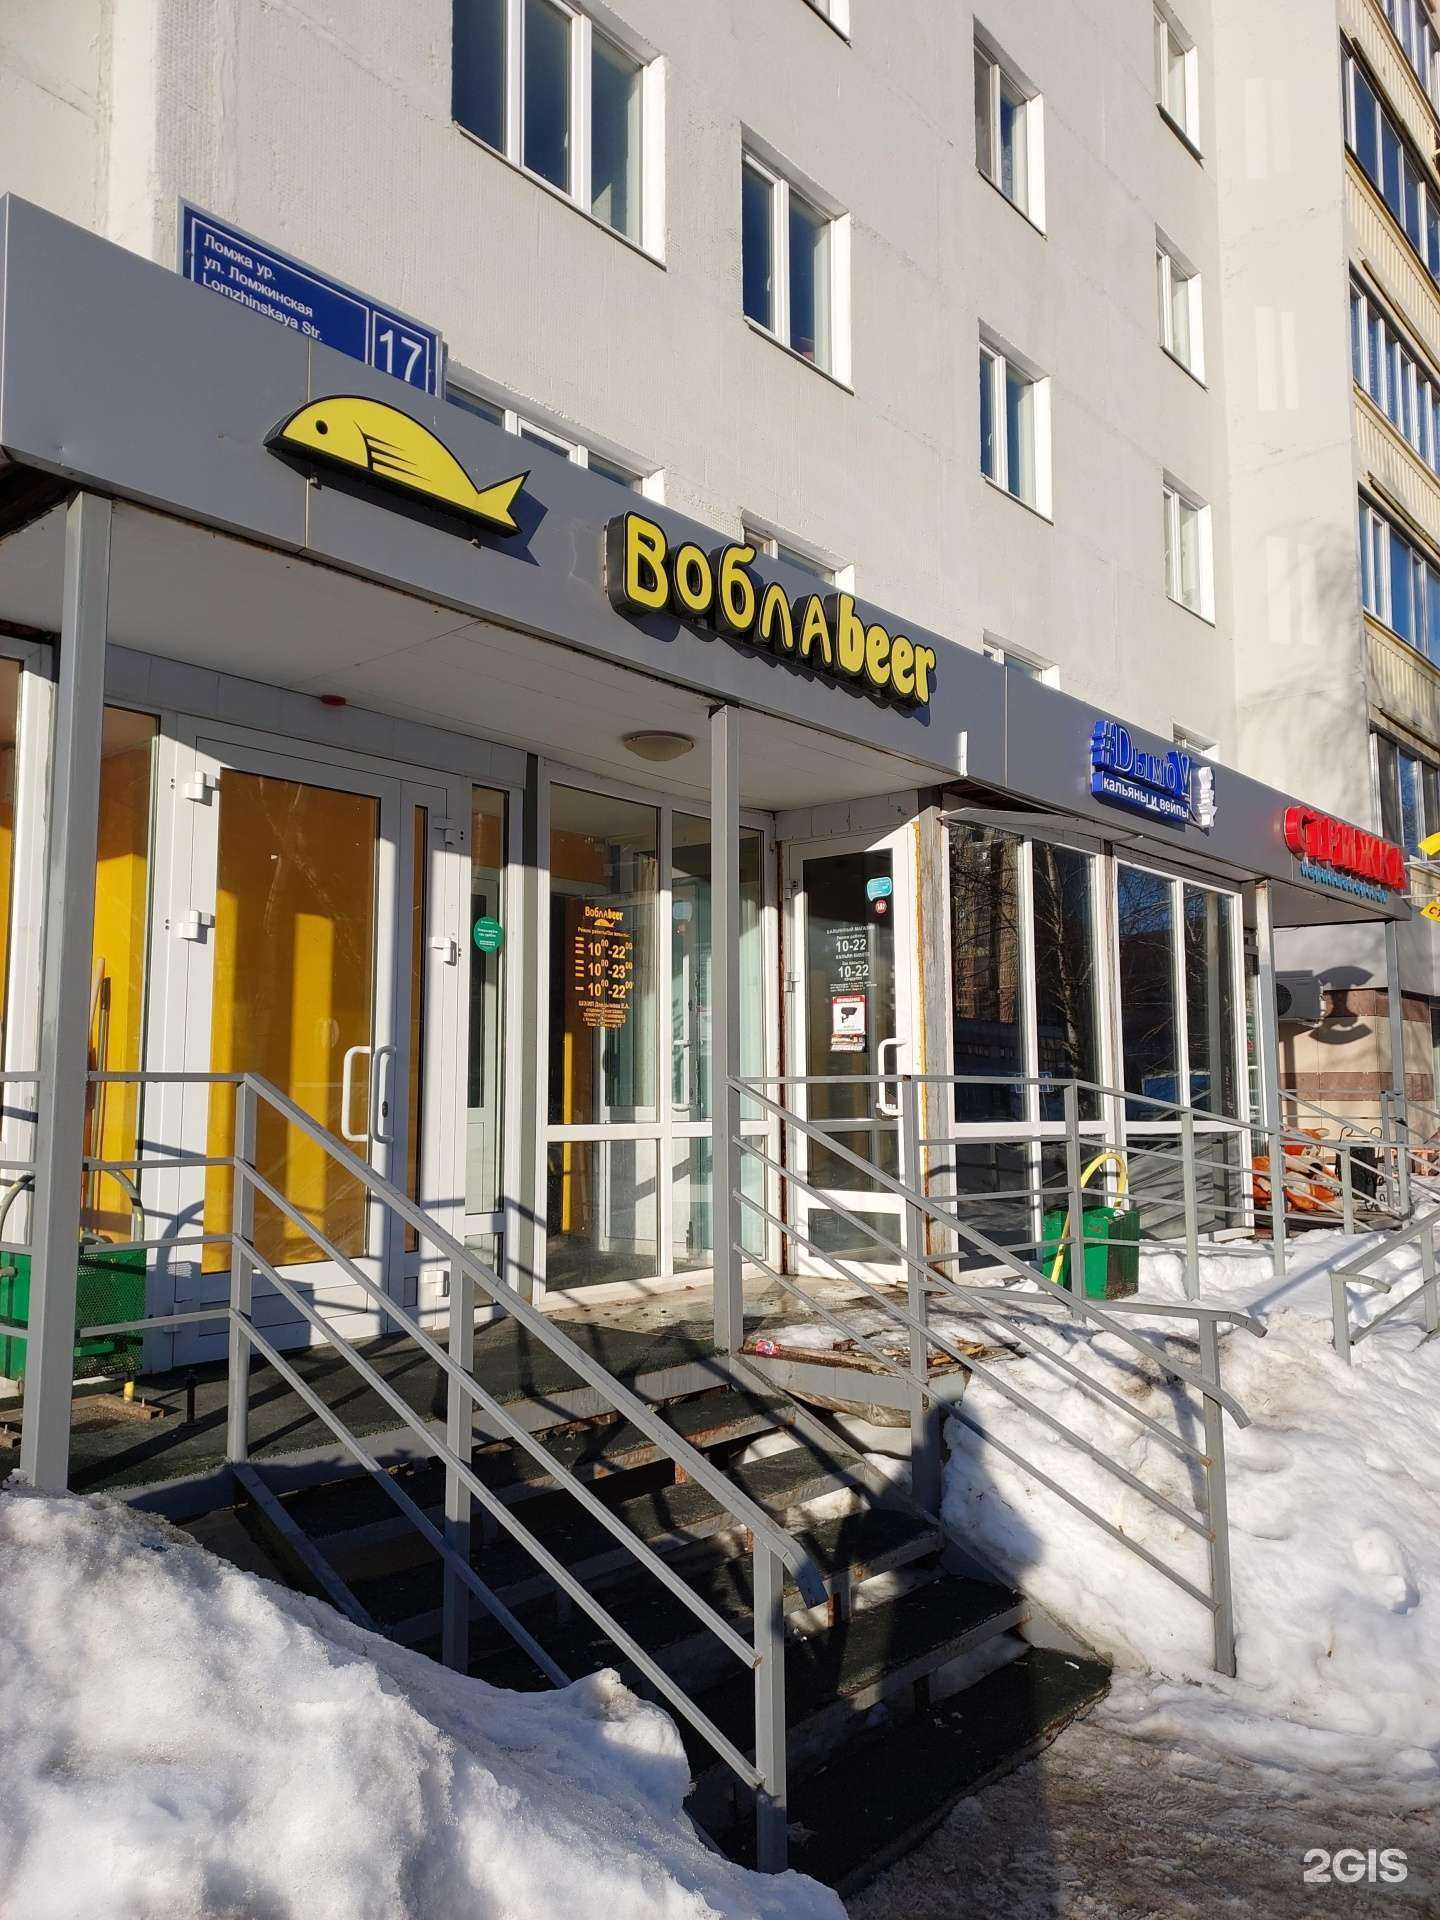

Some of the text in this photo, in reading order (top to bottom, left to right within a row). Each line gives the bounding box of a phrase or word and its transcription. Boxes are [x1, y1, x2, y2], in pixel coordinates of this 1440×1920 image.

[203, 233, 277, 281] Ломжа ур.
[202, 272, 323, 341] Lomzhinskaya Str.
[203, 256, 314, 318] ул. Ломжинская
[379, 329, 422, 382] 17
[1103, 776, 1190, 818] кальяны и вейпы
[835, 938, 867, 953] 10-22
[838, 964, 869, 978] 10-22
